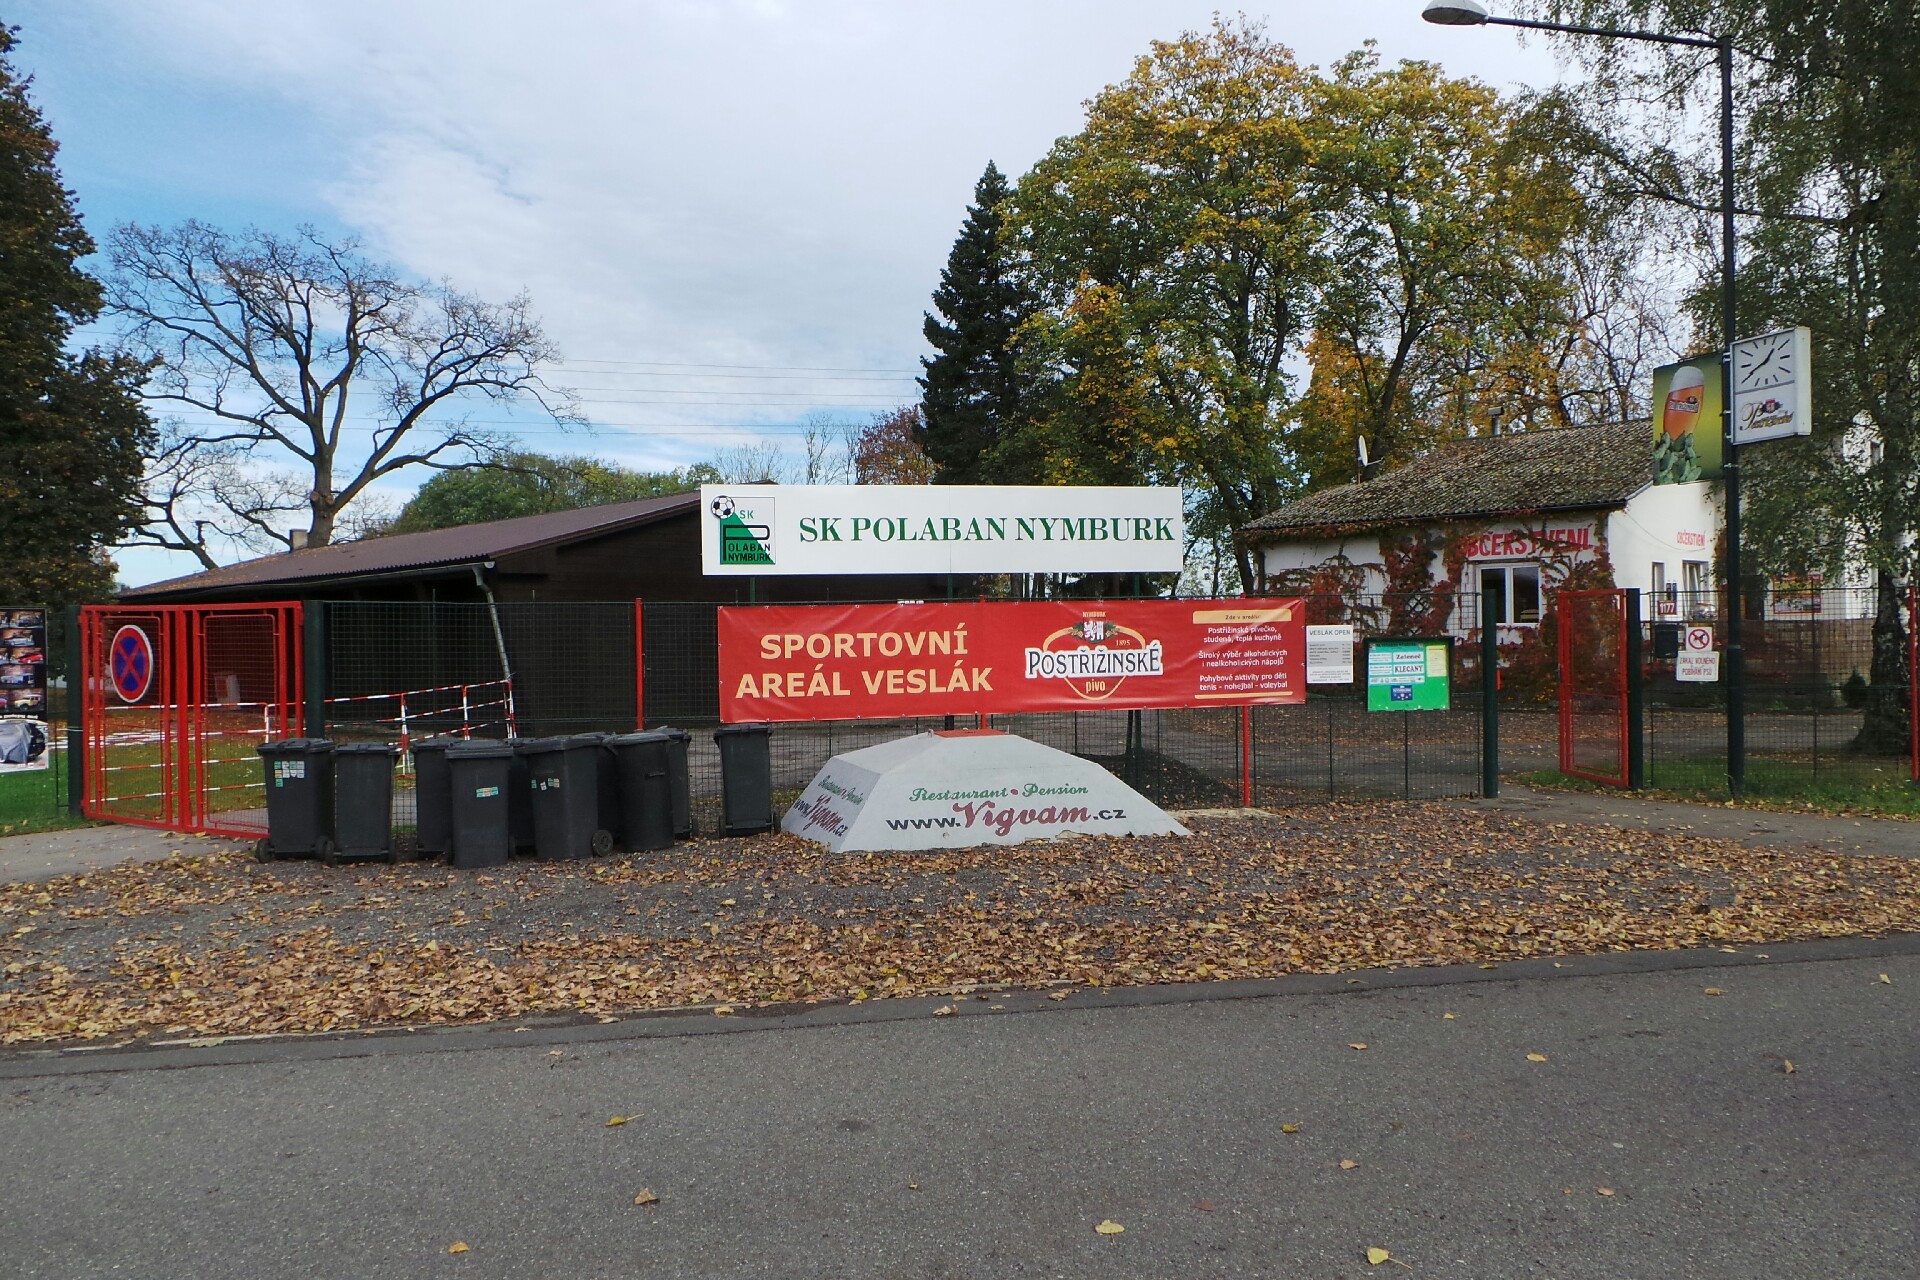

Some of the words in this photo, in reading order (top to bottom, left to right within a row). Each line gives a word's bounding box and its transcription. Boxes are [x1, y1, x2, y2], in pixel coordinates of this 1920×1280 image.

[740, 509, 754, 519] SK
[799, 517, 843, 542] SK
[850, 517, 1008, 542] POLABAN
[1014, 517, 1176, 542] NYMBURK
[728, 552, 771, 562] NYMBURK
[1660, 602, 1675, 613] 1177
[760, 622, 968, 660] SPORTOVNÍ
[1115, 639, 1131, 647] 1895
[1203, 634, 1234, 643] studená,
[1236, 633, 1253, 642] teplá
[1254, 632, 1282, 642] kuchyně
[1198, 649, 1220, 659] Široký
[1222, 649, 1241, 659] výběr
[1243, 649, 1288, 659] alkoholických
[1206, 658, 1260, 668] nealkoholických
[1261, 657, 1284, 666] nápojů
[1394, 665, 1423, 673] KLECANY
[735, 663, 851, 698] AREÁL
[860, 659, 994, 695] VESLÁK
[1200, 674, 1234, 683] Pohybové
[1234, 672, 1260, 681] aktivity
[1261, 673, 1273, 681] pro
[1274, 671, 1287, 680] děti
[1085, 679, 1106, 693] pivo
[1200, 682, 1217, 691] tenis
[1224, 681, 1254, 691] nohejbal
[909, 786, 1008, 801] Restaurant
[1022, 783, 1089, 797] Pension
[886, 800, 1127, 837] www.Vigvam.cz
